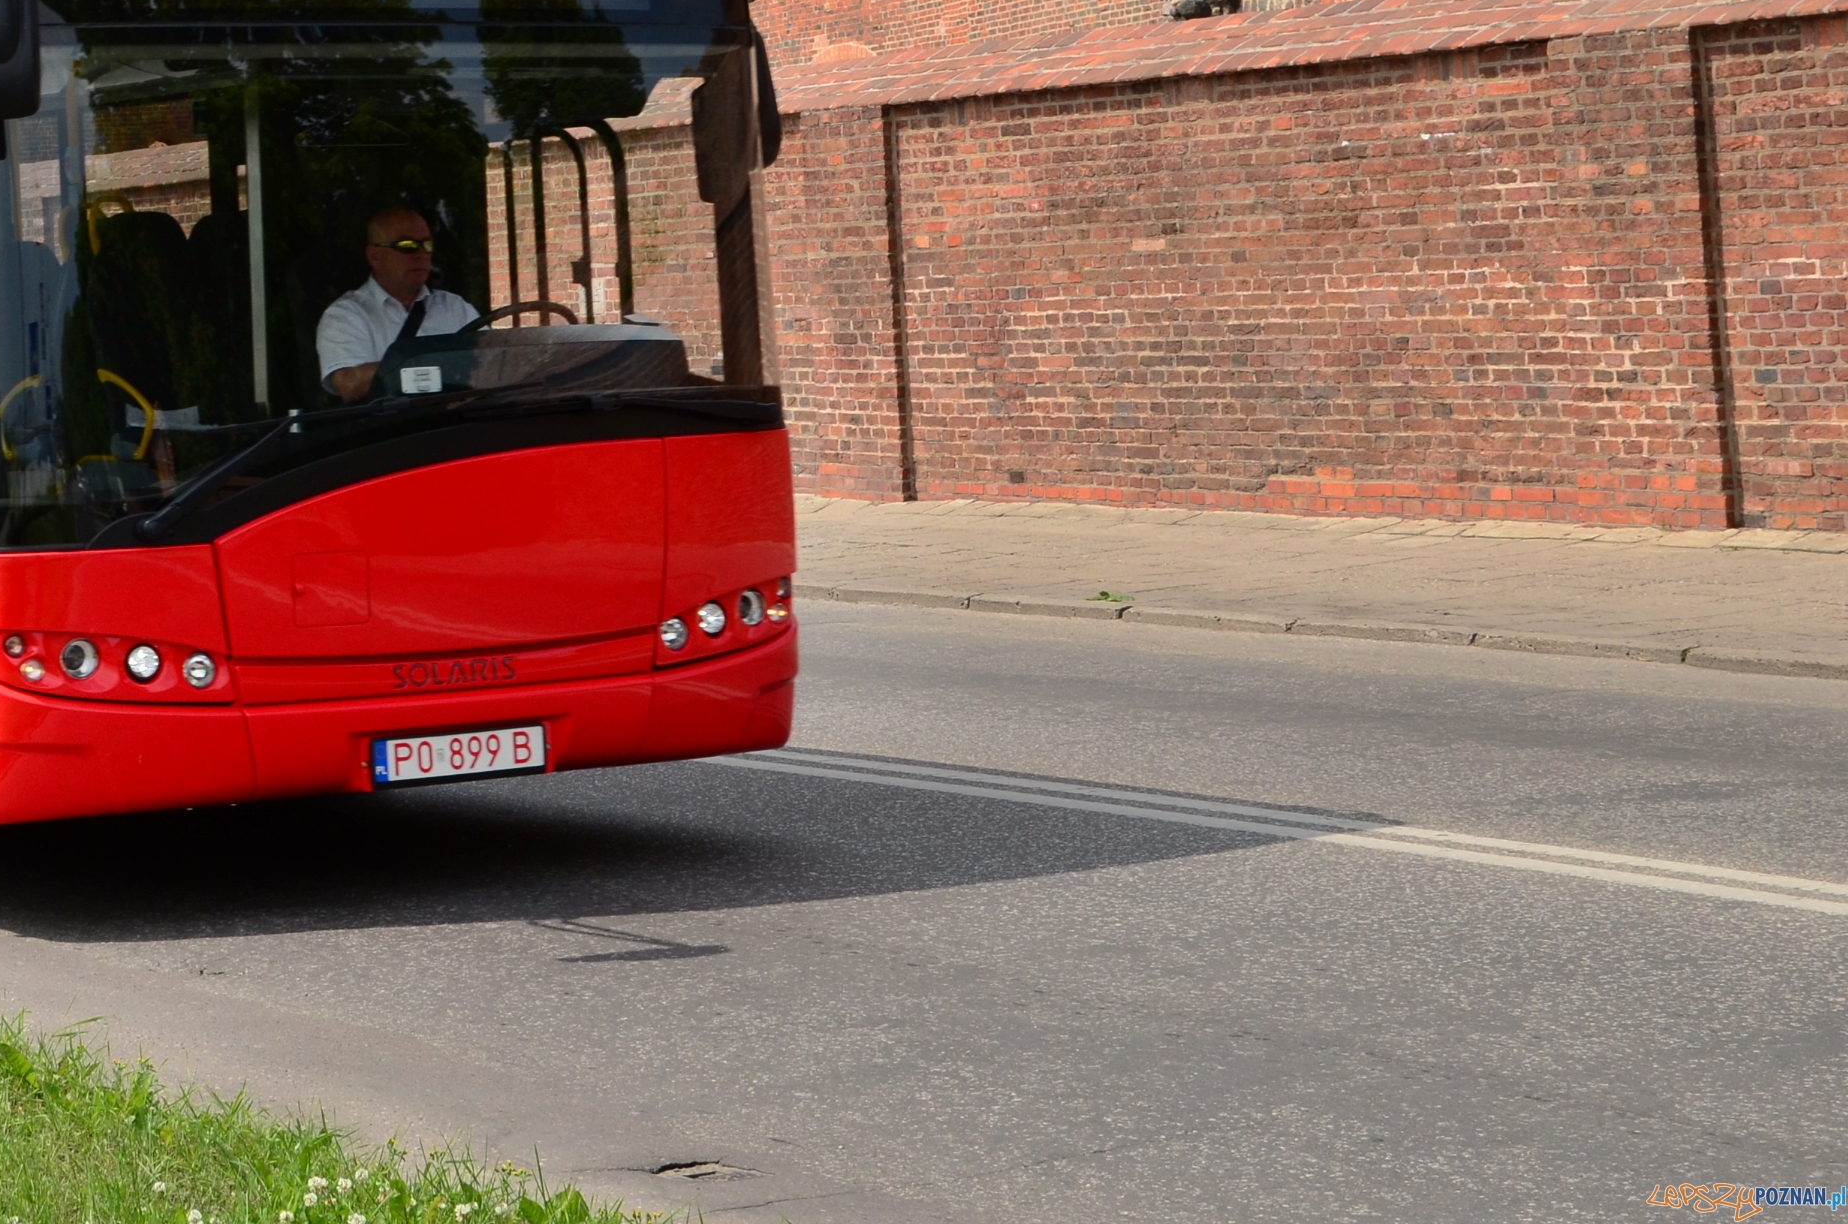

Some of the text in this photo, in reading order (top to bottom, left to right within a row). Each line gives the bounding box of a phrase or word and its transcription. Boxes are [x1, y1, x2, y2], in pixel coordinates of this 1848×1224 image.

[392, 657, 517, 690] SOLARIS
[450, 734, 500, 770] 899
[512, 731, 532, 764] B
[375, 766, 388, 775] PL
